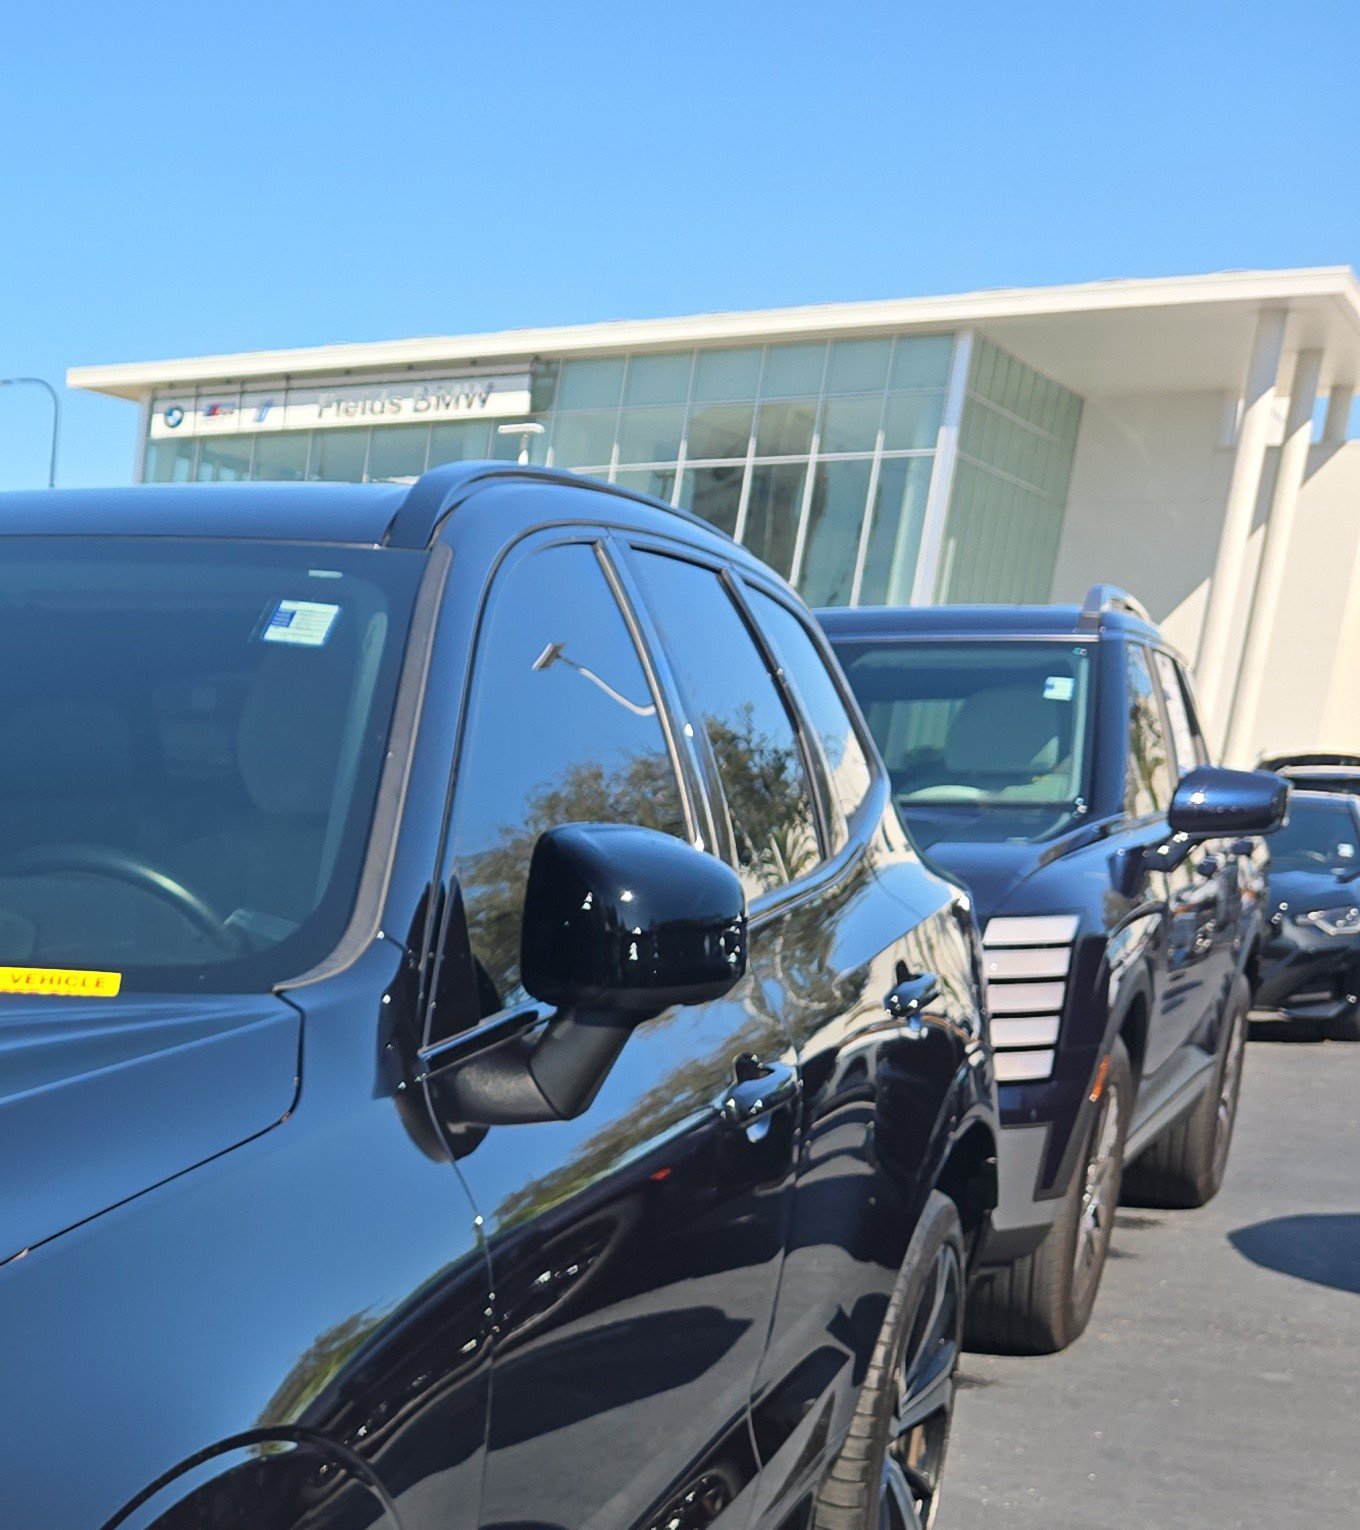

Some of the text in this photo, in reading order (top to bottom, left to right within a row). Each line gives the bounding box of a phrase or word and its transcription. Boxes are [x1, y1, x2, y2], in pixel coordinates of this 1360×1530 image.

[318, 383, 493, 418] Fields BMW
[11, 973, 108, 989] VEHICLE
